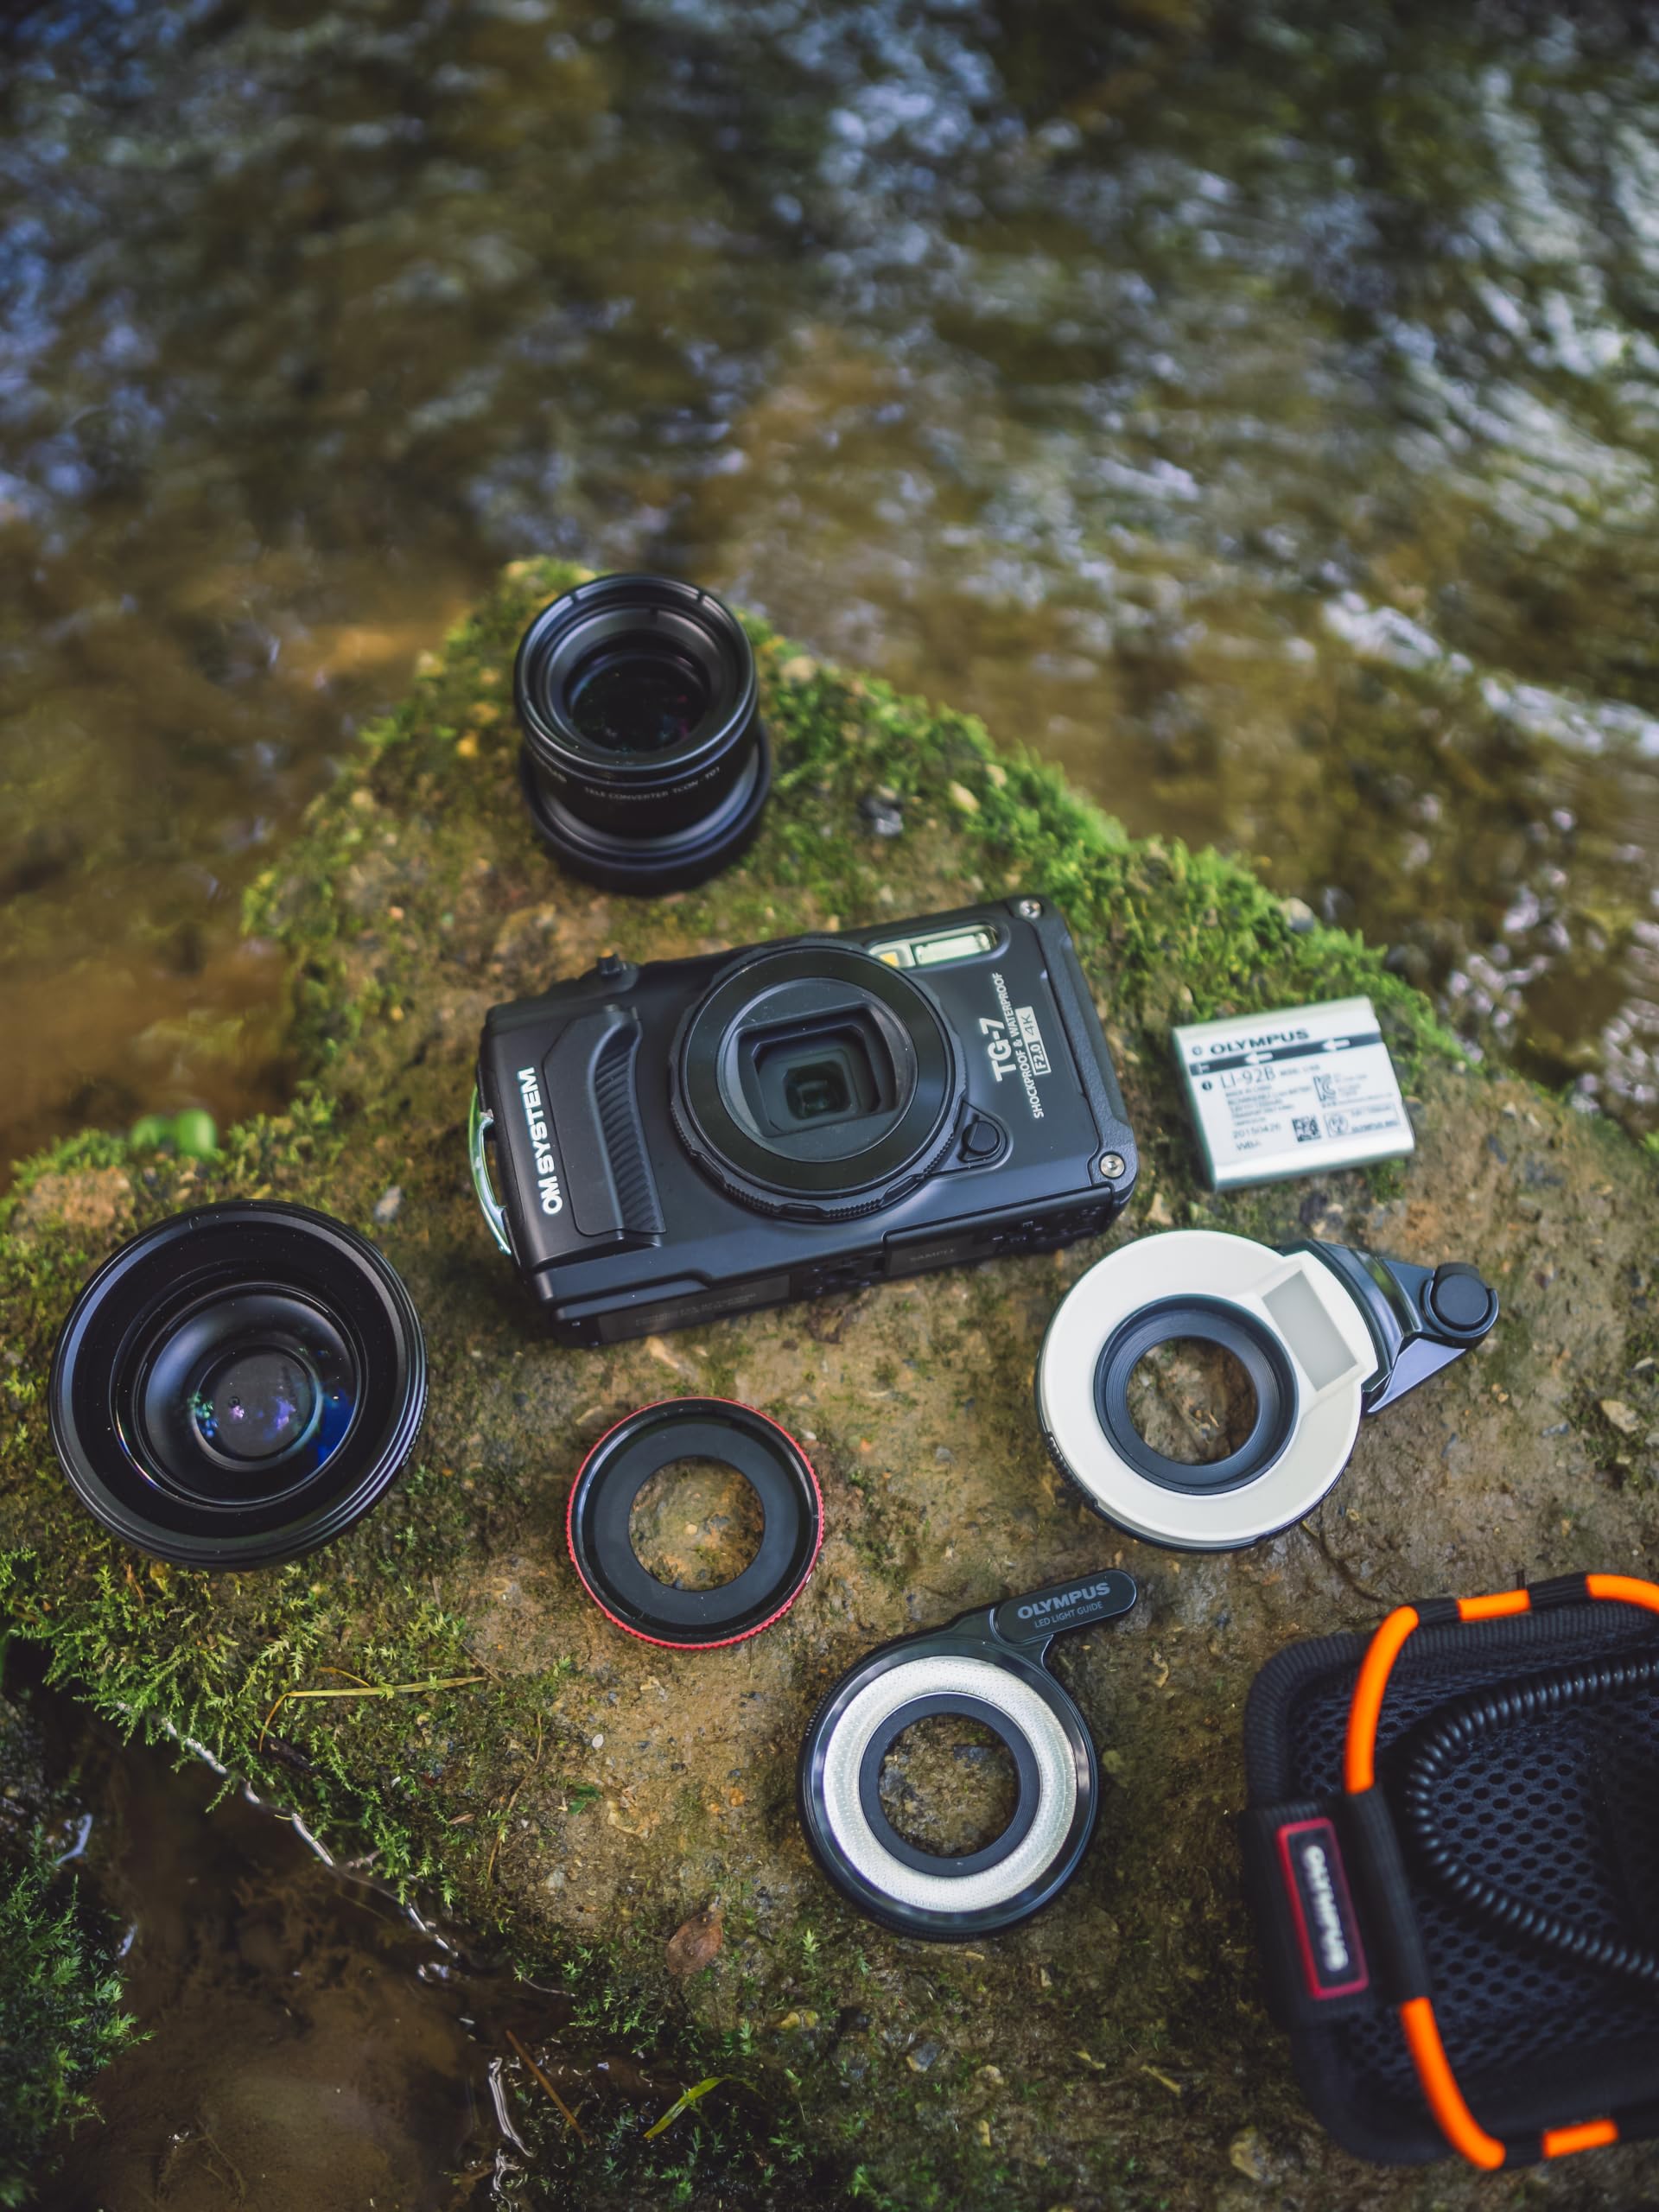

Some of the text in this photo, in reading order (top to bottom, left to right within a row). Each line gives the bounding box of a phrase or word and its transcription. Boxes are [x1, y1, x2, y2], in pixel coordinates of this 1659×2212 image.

[608, 790, 669, 800] CONVERTER
[979, 1017, 1017, 1083] TG-7
[991, 972, 1045, 1119] SHOCKPROOF & WATERPROOF
[1020, 1014, 1046, 1072] F2.0 4K
[1211, 1028, 1309, 1054] OLYMPUS
[1219, 1065, 1276, 1090] LI-92B
[518, 1066, 563, 1215] OM SYSTEM
[1018, 1582, 1110, 1618] OLYMPUS
[1034, 1601, 1103, 1629] LED LIGHT GUIDE
